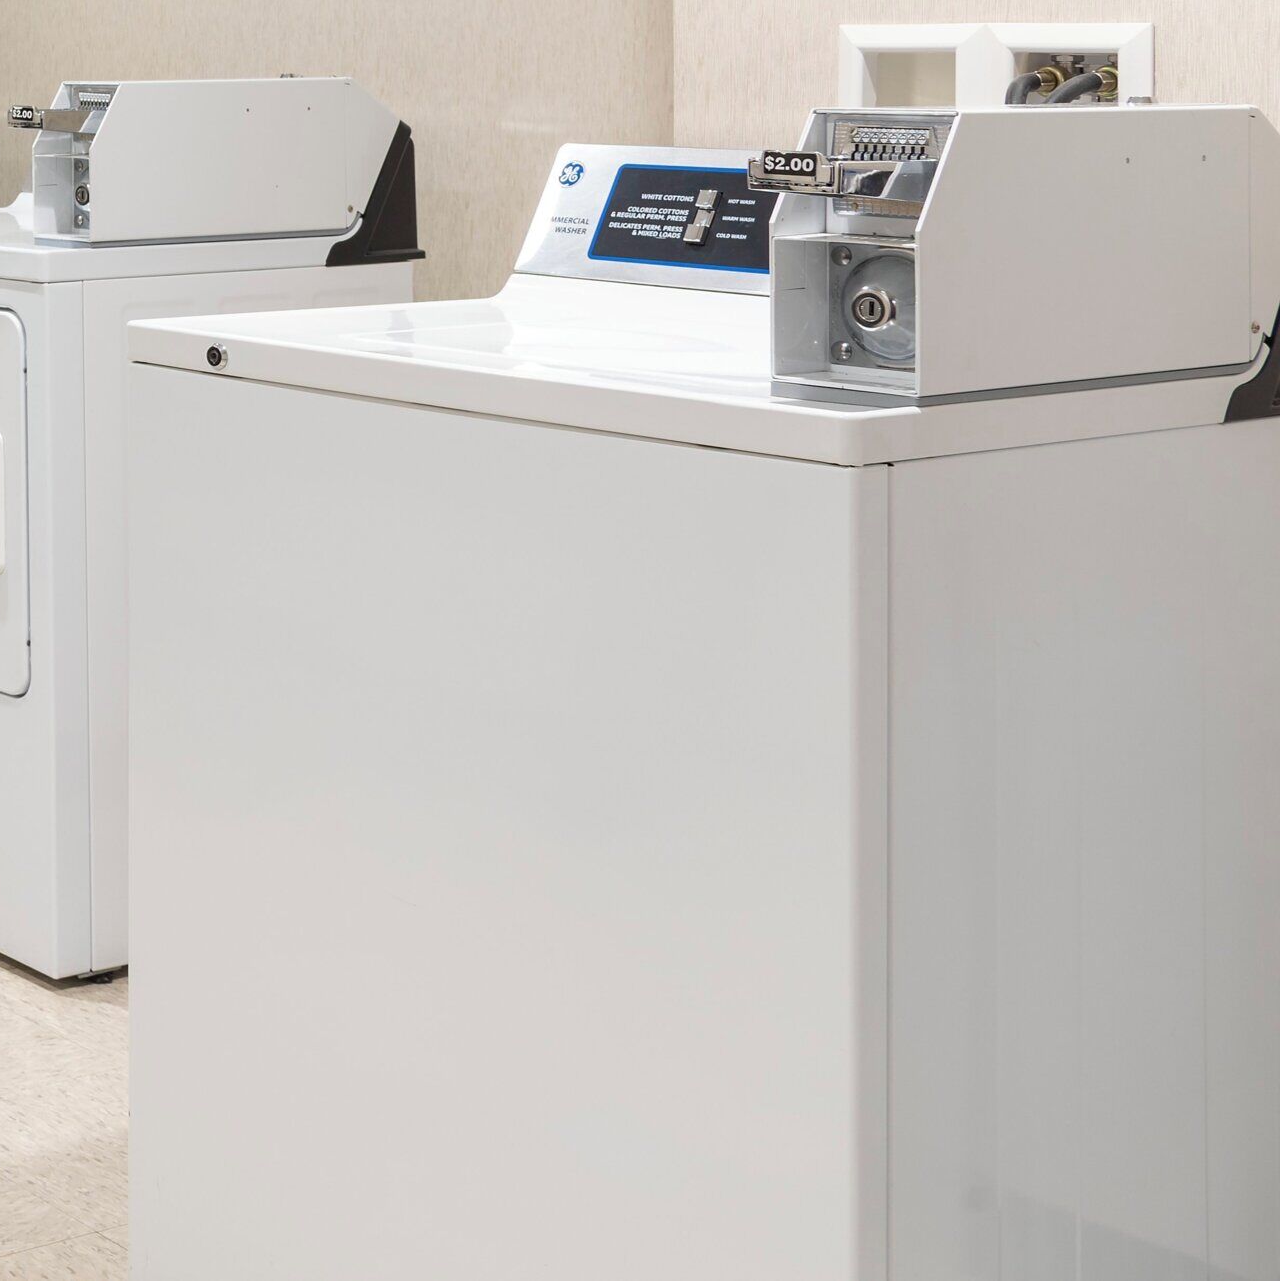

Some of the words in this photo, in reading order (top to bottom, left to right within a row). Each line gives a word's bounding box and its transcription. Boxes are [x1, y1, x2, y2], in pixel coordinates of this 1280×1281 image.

[12, 110, 33, 119] $2.00
[764, 155, 815, 172] $2.00
[641, 193, 663, 201] WHITE
[663, 194, 694, 202] COTTONS
[627, 206, 658, 214] COLORED
[658, 208, 690, 216] COTTONS
[550, 216, 590, 225] MMERCIAL
[554, 226, 588, 235] WASHER
[662, 225, 684, 233] PRESS
